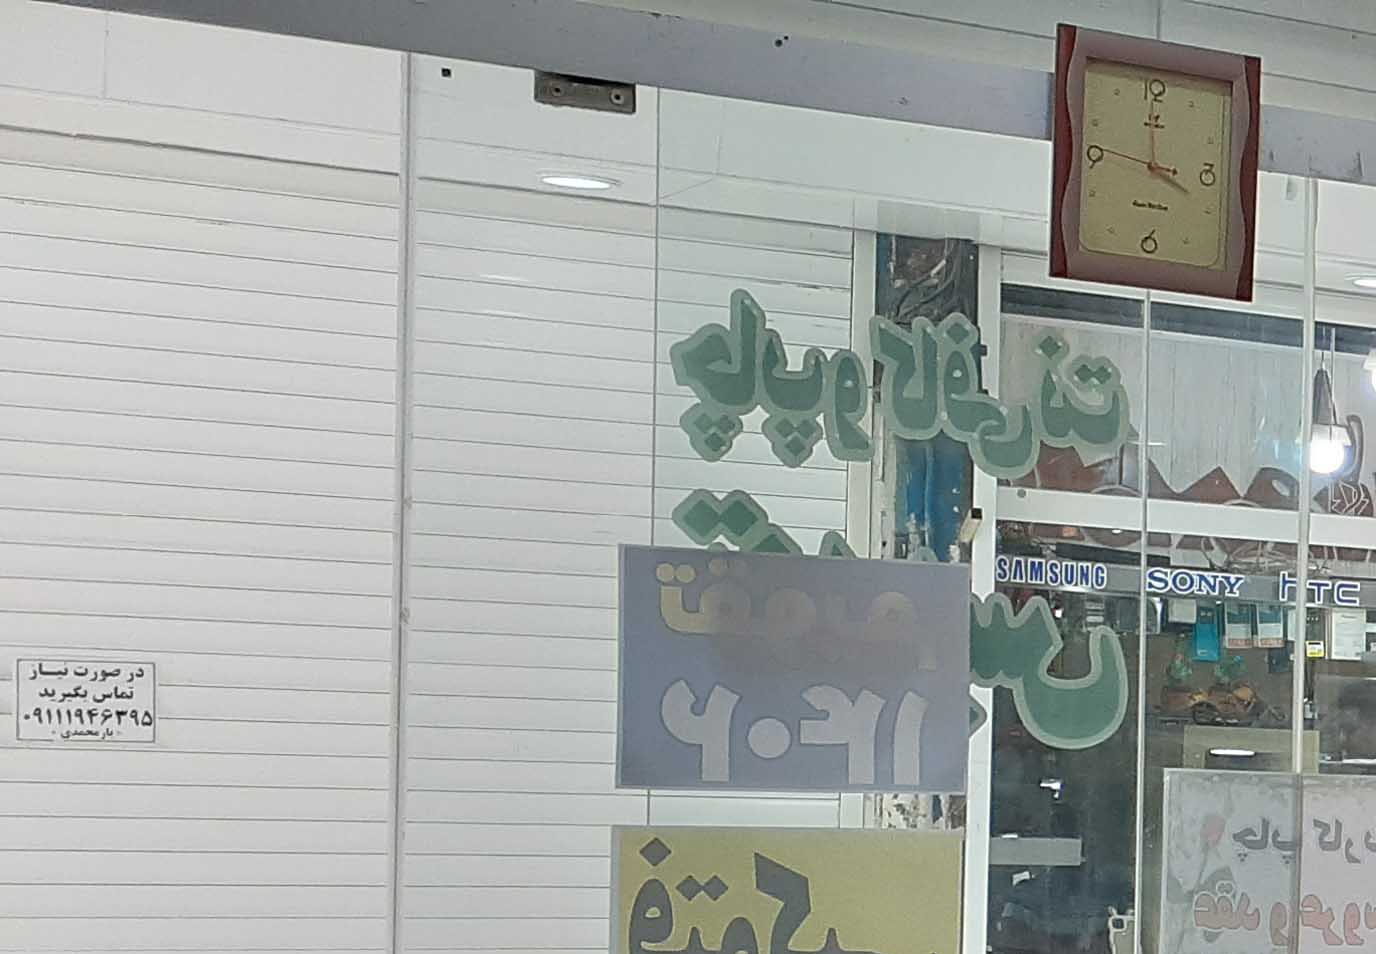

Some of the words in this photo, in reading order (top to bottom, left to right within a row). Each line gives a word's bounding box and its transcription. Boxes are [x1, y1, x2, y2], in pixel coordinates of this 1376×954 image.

[1143, 79, 1167, 103] 12
[1086, 144, 1105, 169] 9
[1199, 162, 1217, 187] 3
[1140, 229, 1159, 254] 6
[996, 557, 1108, 588] SAMSUNG
[1147, 568, 1245, 597] SONY
[28, 662, 69, 681] نیاز
[73, 665, 121, 683] صورت
[126, 667, 145, 683] در
[38, 685, 89, 703] بگیرید
[92, 686, 135, 704] تماس
[23, 706, 154, 727] ۰۹۱۱۱۹۴۶۳۹۵
